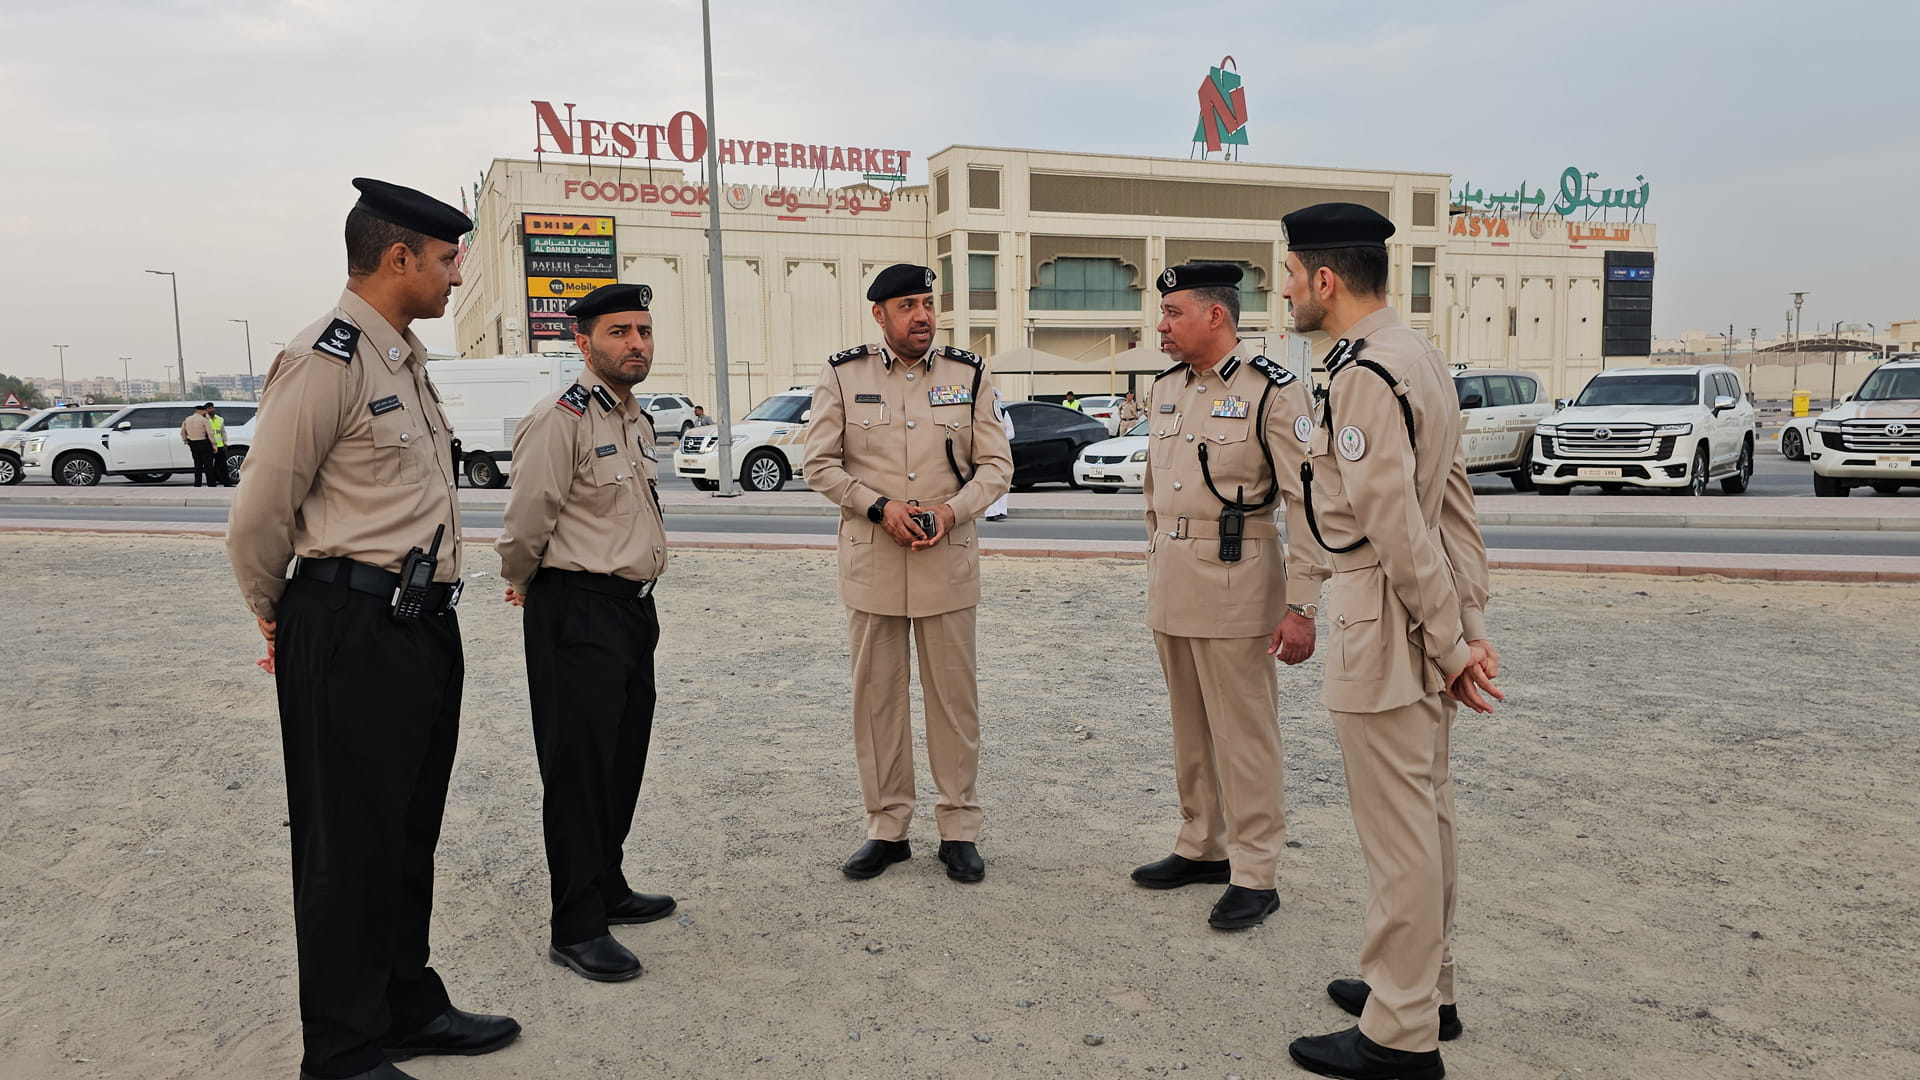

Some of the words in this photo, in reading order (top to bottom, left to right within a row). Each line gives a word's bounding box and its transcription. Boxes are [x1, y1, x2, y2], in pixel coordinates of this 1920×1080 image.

[531, 100, 708, 163] NESTO
[719, 138, 911, 175] HYPERMARKET
[564, 179, 710, 205] FOODBOOK
[764, 187, 833, 215] بوك
[835, 191, 892, 216] فود
[1554, 166, 1650, 216] نستو
[1448, 216, 1509, 238] ASYA
[546, 246, 571, 254] DAHAB
[572, 247, 610, 255] EXCHANGE
[566, 283, 598, 291] Mobile
[532, 322, 567, 330] EXTEL
